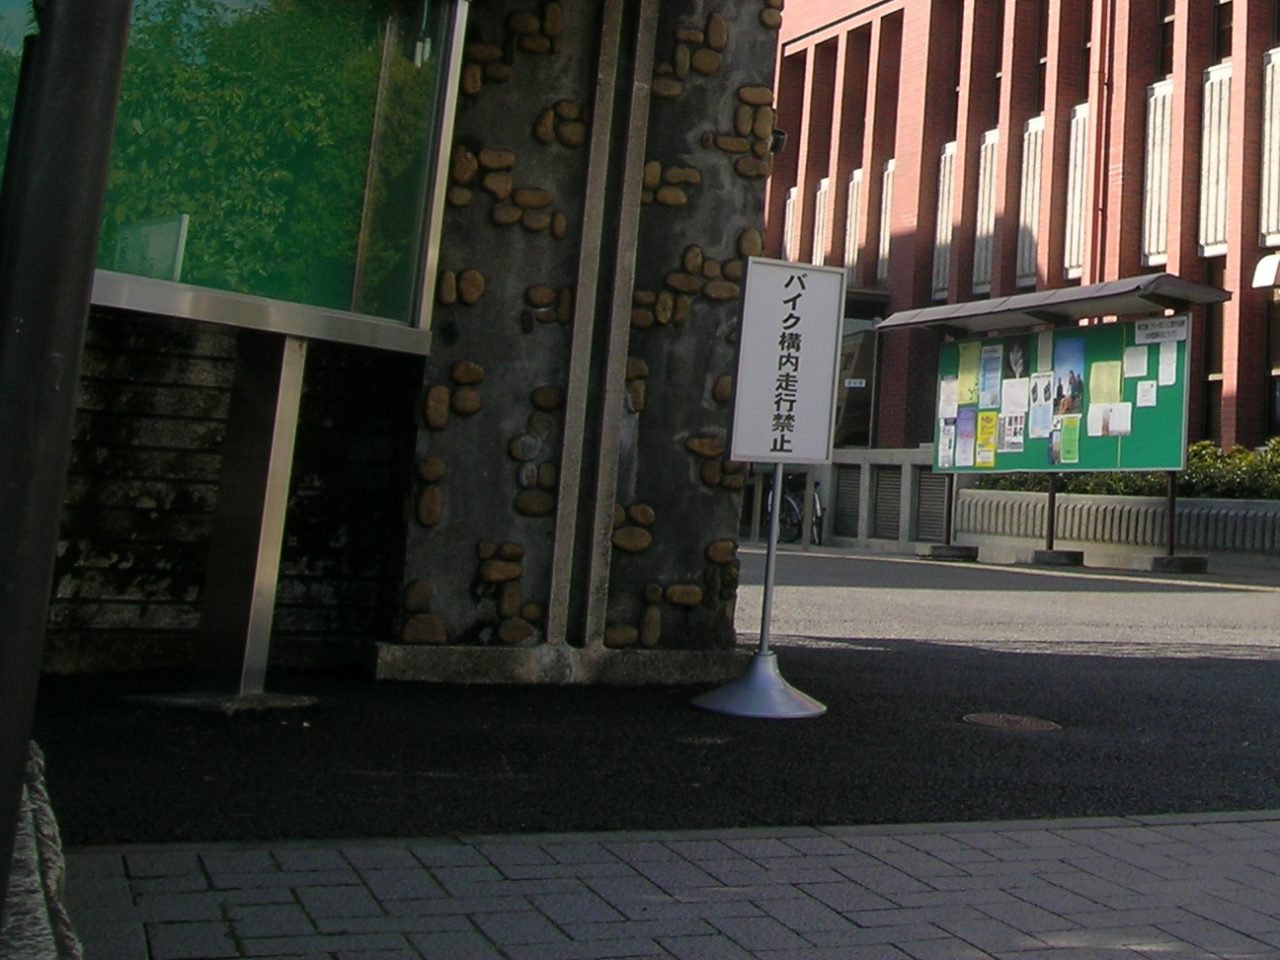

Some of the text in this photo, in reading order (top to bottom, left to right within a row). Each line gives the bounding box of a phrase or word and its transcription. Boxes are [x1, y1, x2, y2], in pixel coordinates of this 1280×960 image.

[769, 273, 808, 453] バイク構内走行禁止
